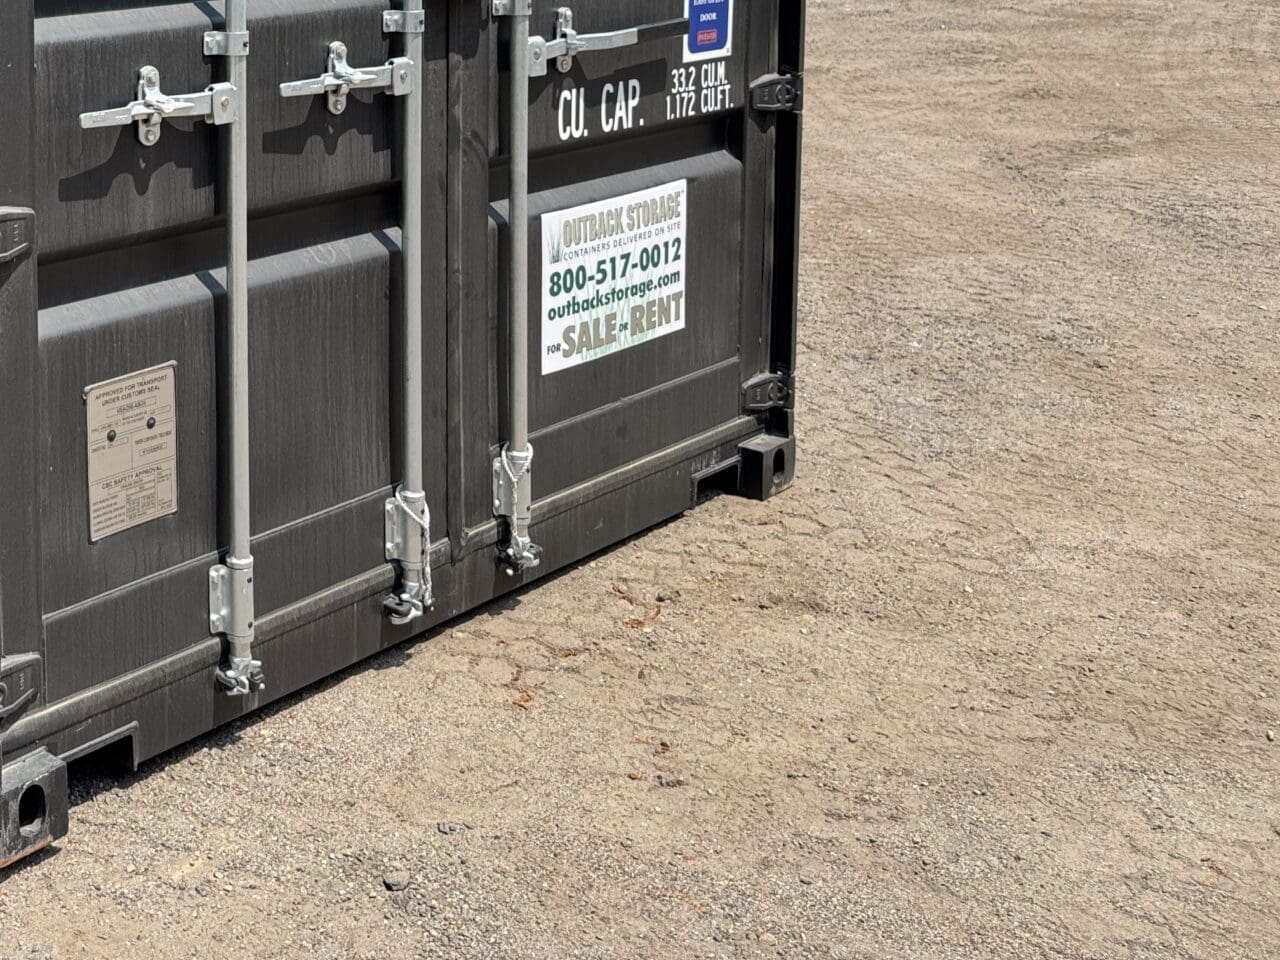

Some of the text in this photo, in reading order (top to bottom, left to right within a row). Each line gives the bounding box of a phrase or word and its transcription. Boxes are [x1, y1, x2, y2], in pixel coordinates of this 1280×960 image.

[700, 12, 717, 22] DOOR
[558, 88, 588, 140] CU.
[601, 79, 644, 133] CAP.
[671, 66, 696, 94] 33.2
[562, 191, 681, 248] OUTBACK STORAGE
[563, 221, 681, 261] CONTAINERS DELIVERED ON SITE
[549, 237, 681, 297] 800-517-0012
[548, 270, 680, 321] outbackstorage.com
[547, 291, 683, 358] FOR SALE OR RENT
[121, 389, 147, 400] CUSTOMS
[147, 385, 161, 393] SEAL
[125, 383, 136, 391] FOR
[137, 374, 168, 387] TRANSPORT
[113, 474, 134, 485] SAFETY
[135, 466, 162, 478] APPROVAL
